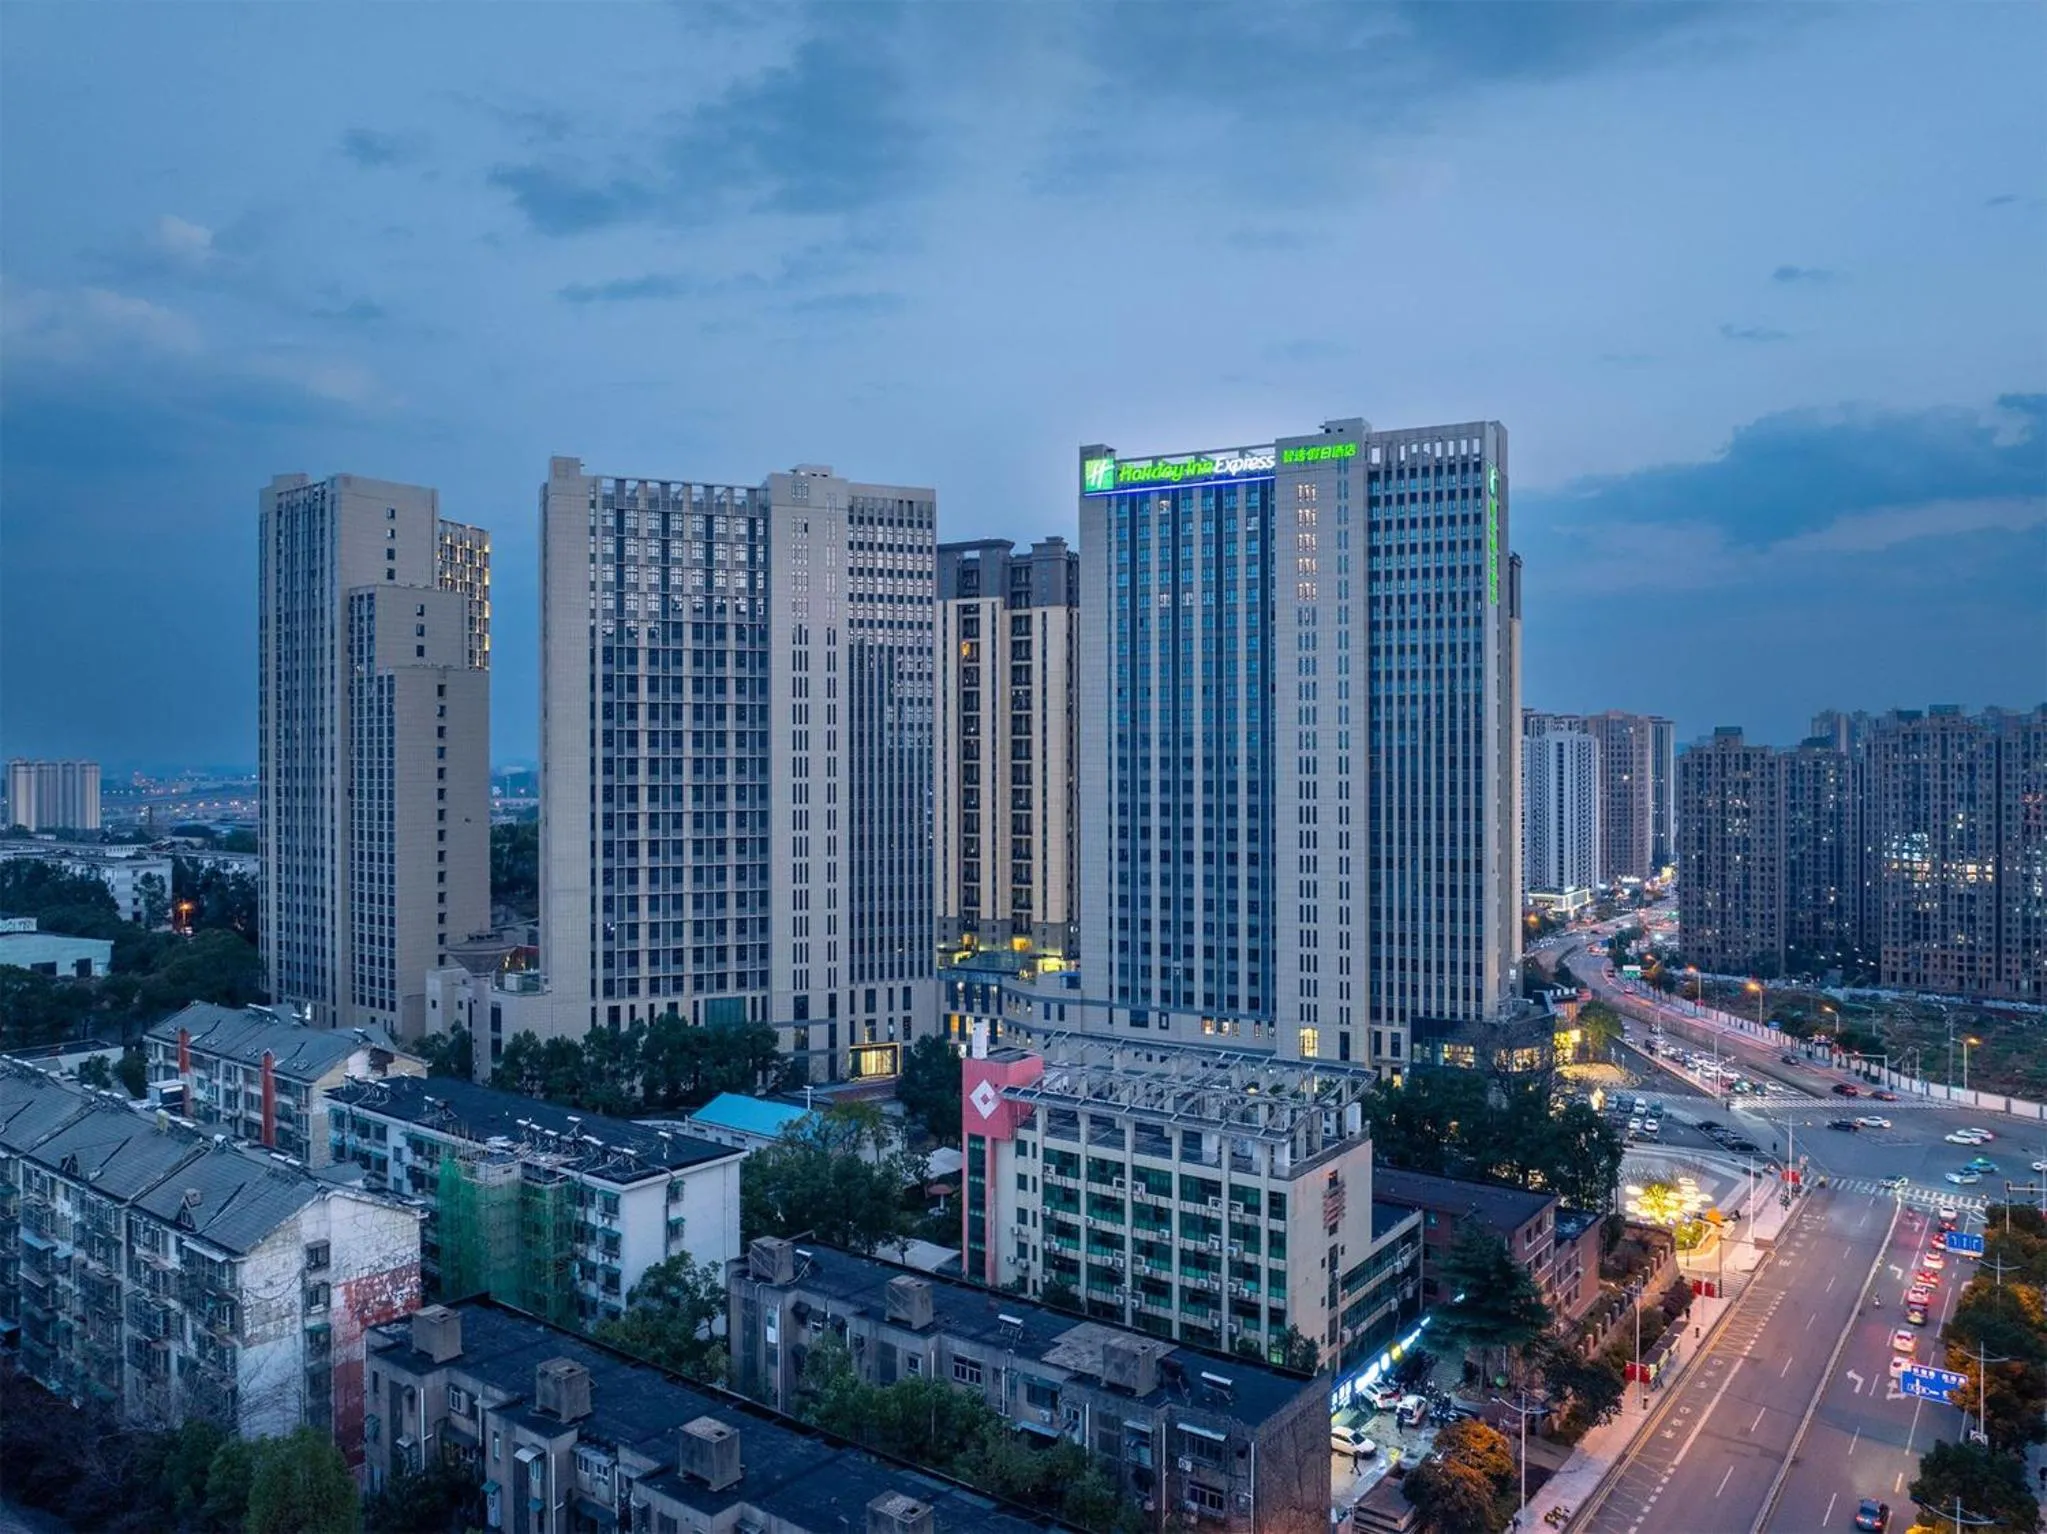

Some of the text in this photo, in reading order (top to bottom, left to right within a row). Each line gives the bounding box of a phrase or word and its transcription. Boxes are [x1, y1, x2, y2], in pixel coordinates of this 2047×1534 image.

[1118, 455, 1276, 482] Holiday Inn Express
